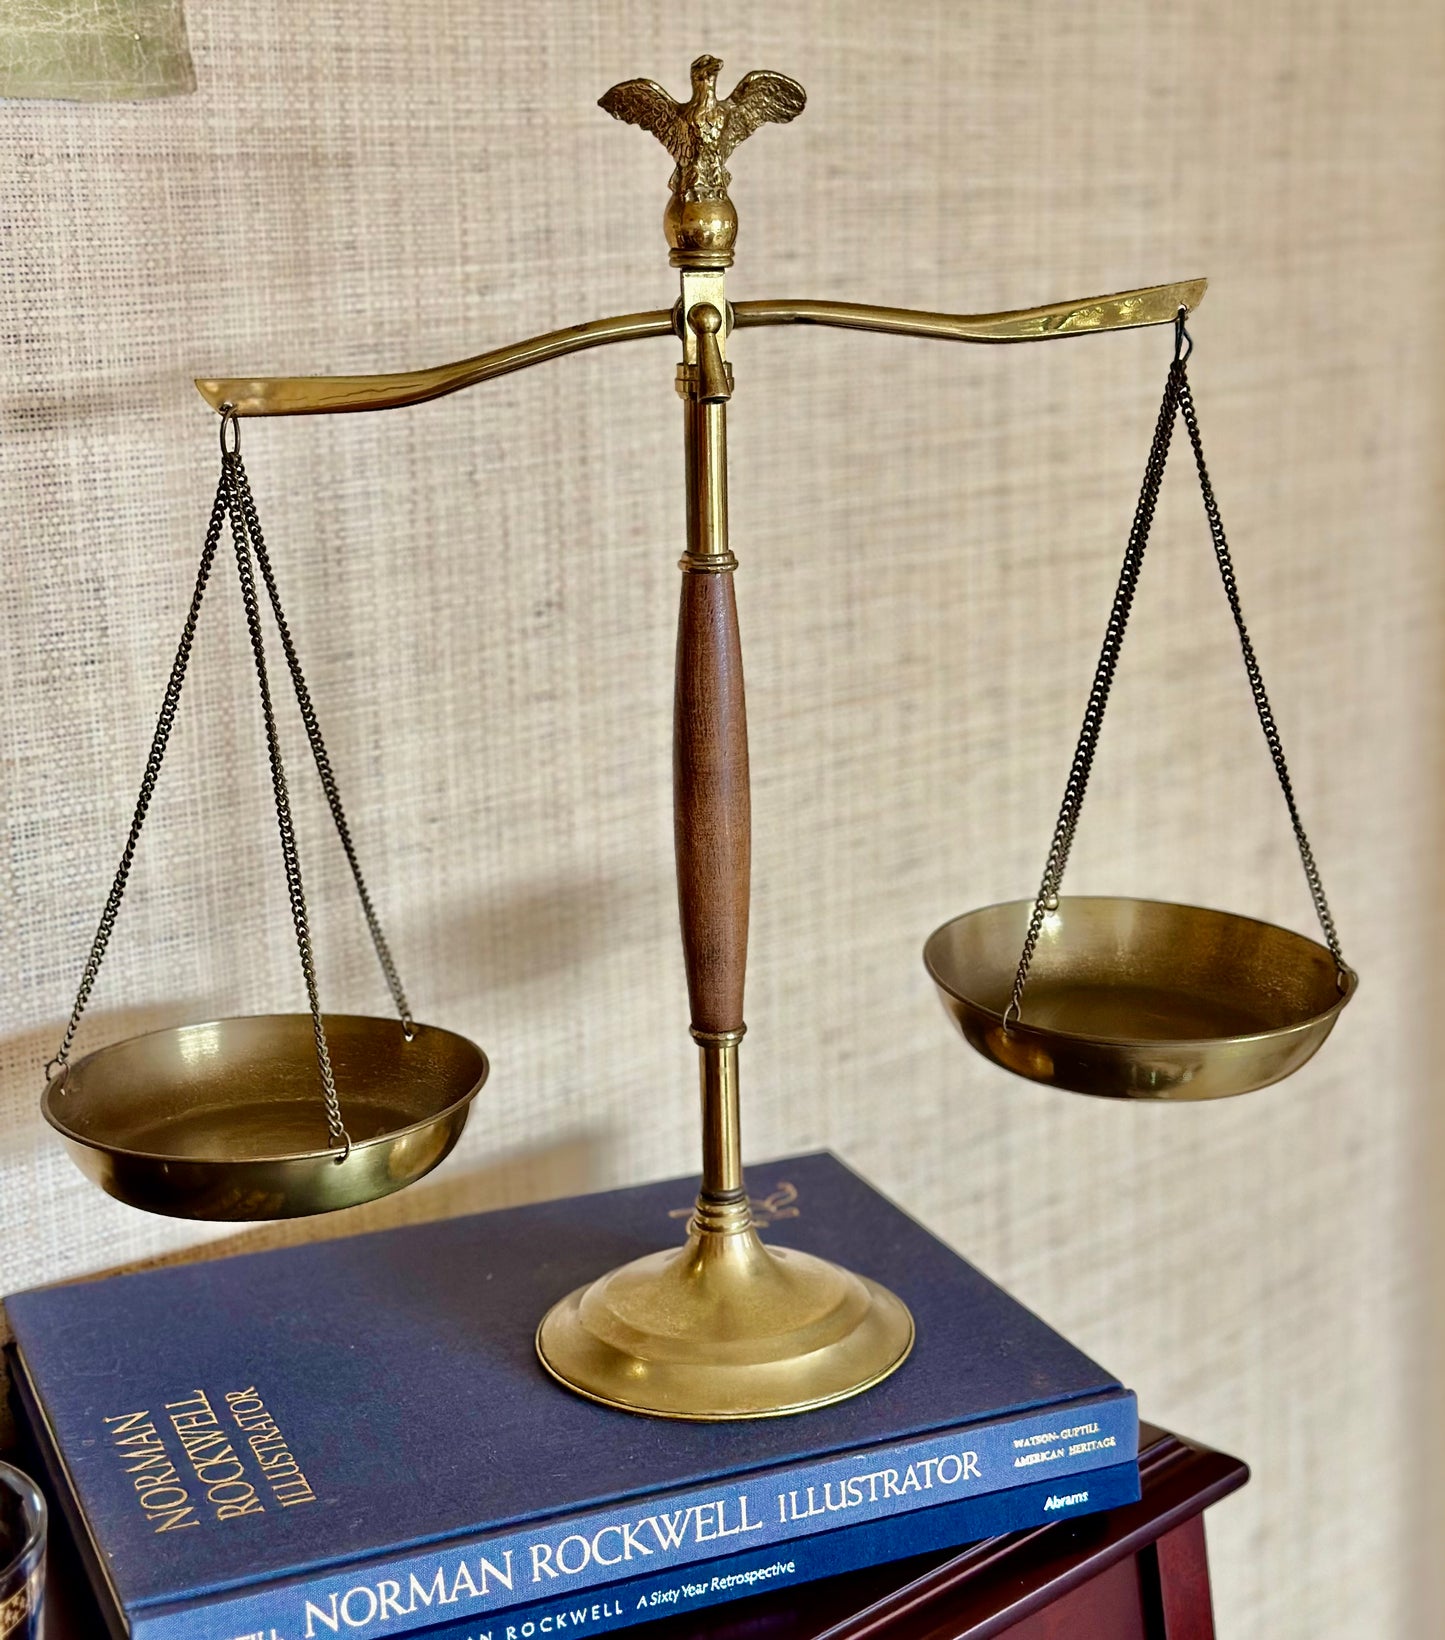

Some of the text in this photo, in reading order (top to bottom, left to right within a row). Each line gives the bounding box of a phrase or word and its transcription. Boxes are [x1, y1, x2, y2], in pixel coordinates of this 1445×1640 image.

[102, 1409, 200, 1533] NORMAN
[165, 1389, 265, 1521] ROCKWELL
[225, 1386, 317, 1507] ILLUSTRATOR
[1013, 1436, 1117, 1468] AMERICAN HERITAGE
[1043, 1491, 1089, 1511] Abrams
[304, 1451, 982, 1639] NORMAN ROCKWELL ILLUSTRATOR
[506, 1600, 623, 1640] ROCKWELL
[636, 1595, 648, 1609] A
[649, 1588, 681, 1606] Sixty
[681, 1583, 709, 1598] Year
[711, 1561, 796, 1592] Retrospective
